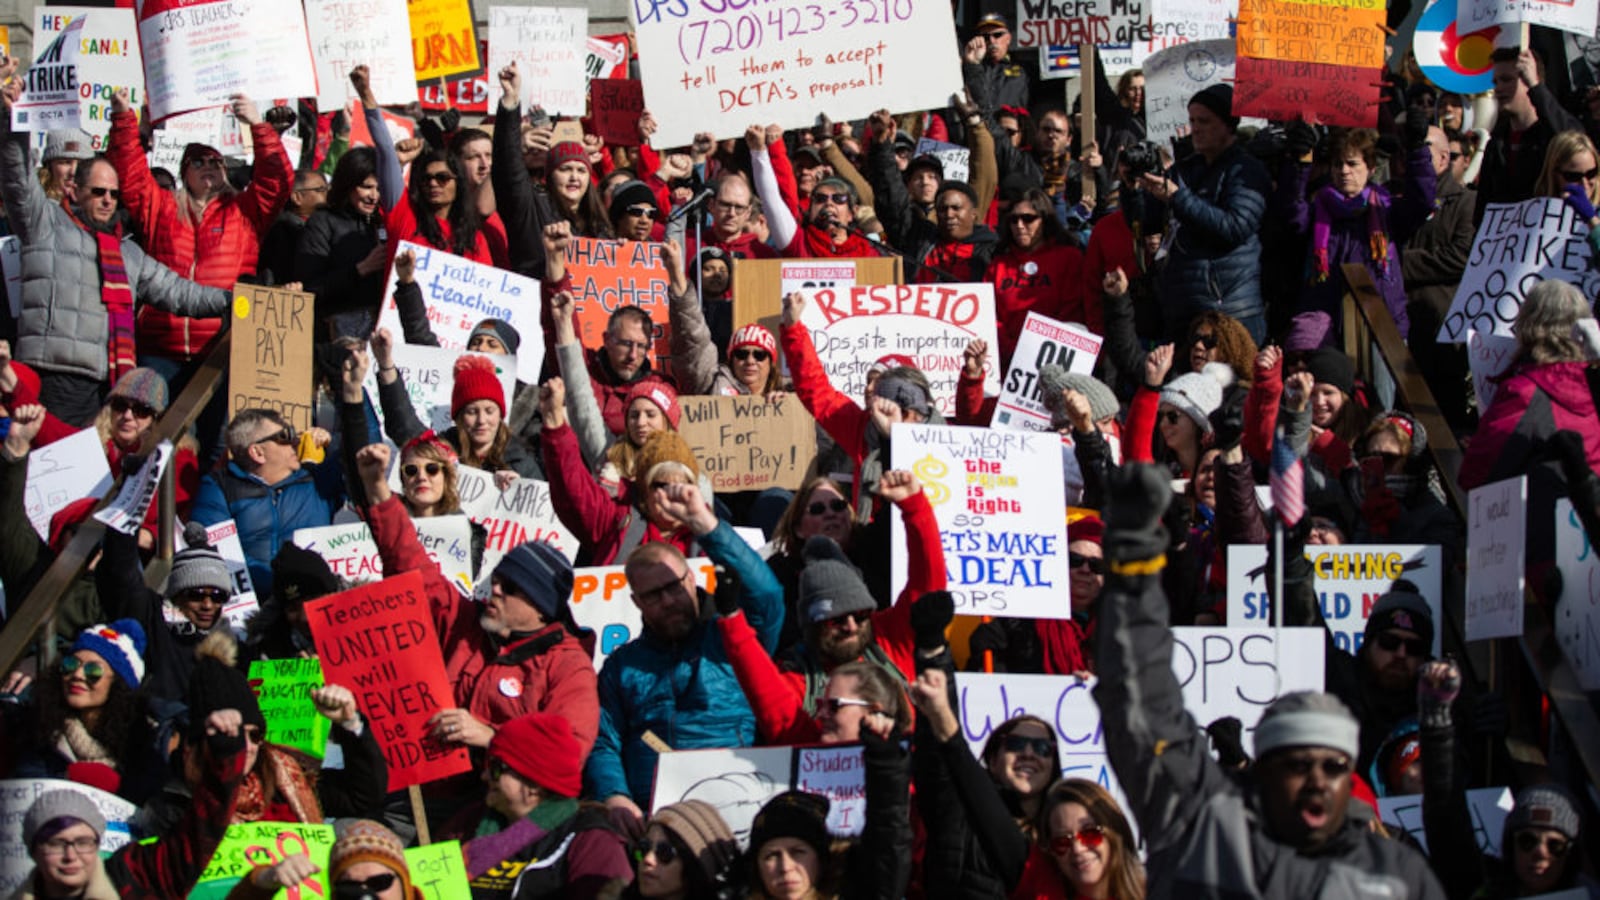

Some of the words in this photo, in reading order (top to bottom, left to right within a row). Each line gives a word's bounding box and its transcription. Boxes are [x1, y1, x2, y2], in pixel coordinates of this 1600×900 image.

[1018, 15, 1111, 47] STUDENTS
[1152, 21, 1199, 37] ere's
[411, 29, 475, 71] URN
[680, 66, 715, 90] tell
[740, 56, 785, 76] them
[797, 48, 813, 67] to
[825, 40, 887, 64] accept
[1334, 43, 1376, 66] FAIR
[21, 65, 77, 92] TRIKE
[809, 63, 883, 98] proposal!
[1485, 199, 1585, 237] TEACHE
[1470, 233, 1582, 271] STRIKE
[428, 275, 512, 322] teaching
[569, 275, 668, 313] EACHER
[814, 285, 979, 327] RESPETO
[252, 289, 305, 332] FAIR
[256, 328, 286, 367] PAY
[1035, 340, 1076, 373] ON
[684, 400, 719, 423] Will
[732, 397, 783, 419] Work
[720, 423, 757, 447] For
[912, 428, 961, 446] WILL
[970, 431, 1037, 455] WORK
[691, 446, 736, 472] Fair
[949, 446, 1008, 460] WHEN
[964, 457, 1002, 474] the
[711, 472, 740, 488] God
[967, 485, 984, 497] is
[495, 483, 556, 524] RATHE
[448, 538, 468, 563] be
[940, 529, 981, 552] ET'S
[988, 531, 1057, 556] MAKE
[958, 555, 1053, 589] DEAL
[1308, 552, 1404, 580] CHING
[317, 590, 417, 627] Teachers
[322, 620, 426, 666] UNITED
[353, 662, 398, 688] will
[355, 681, 440, 721] EVER
[381, 722, 408, 743] be
